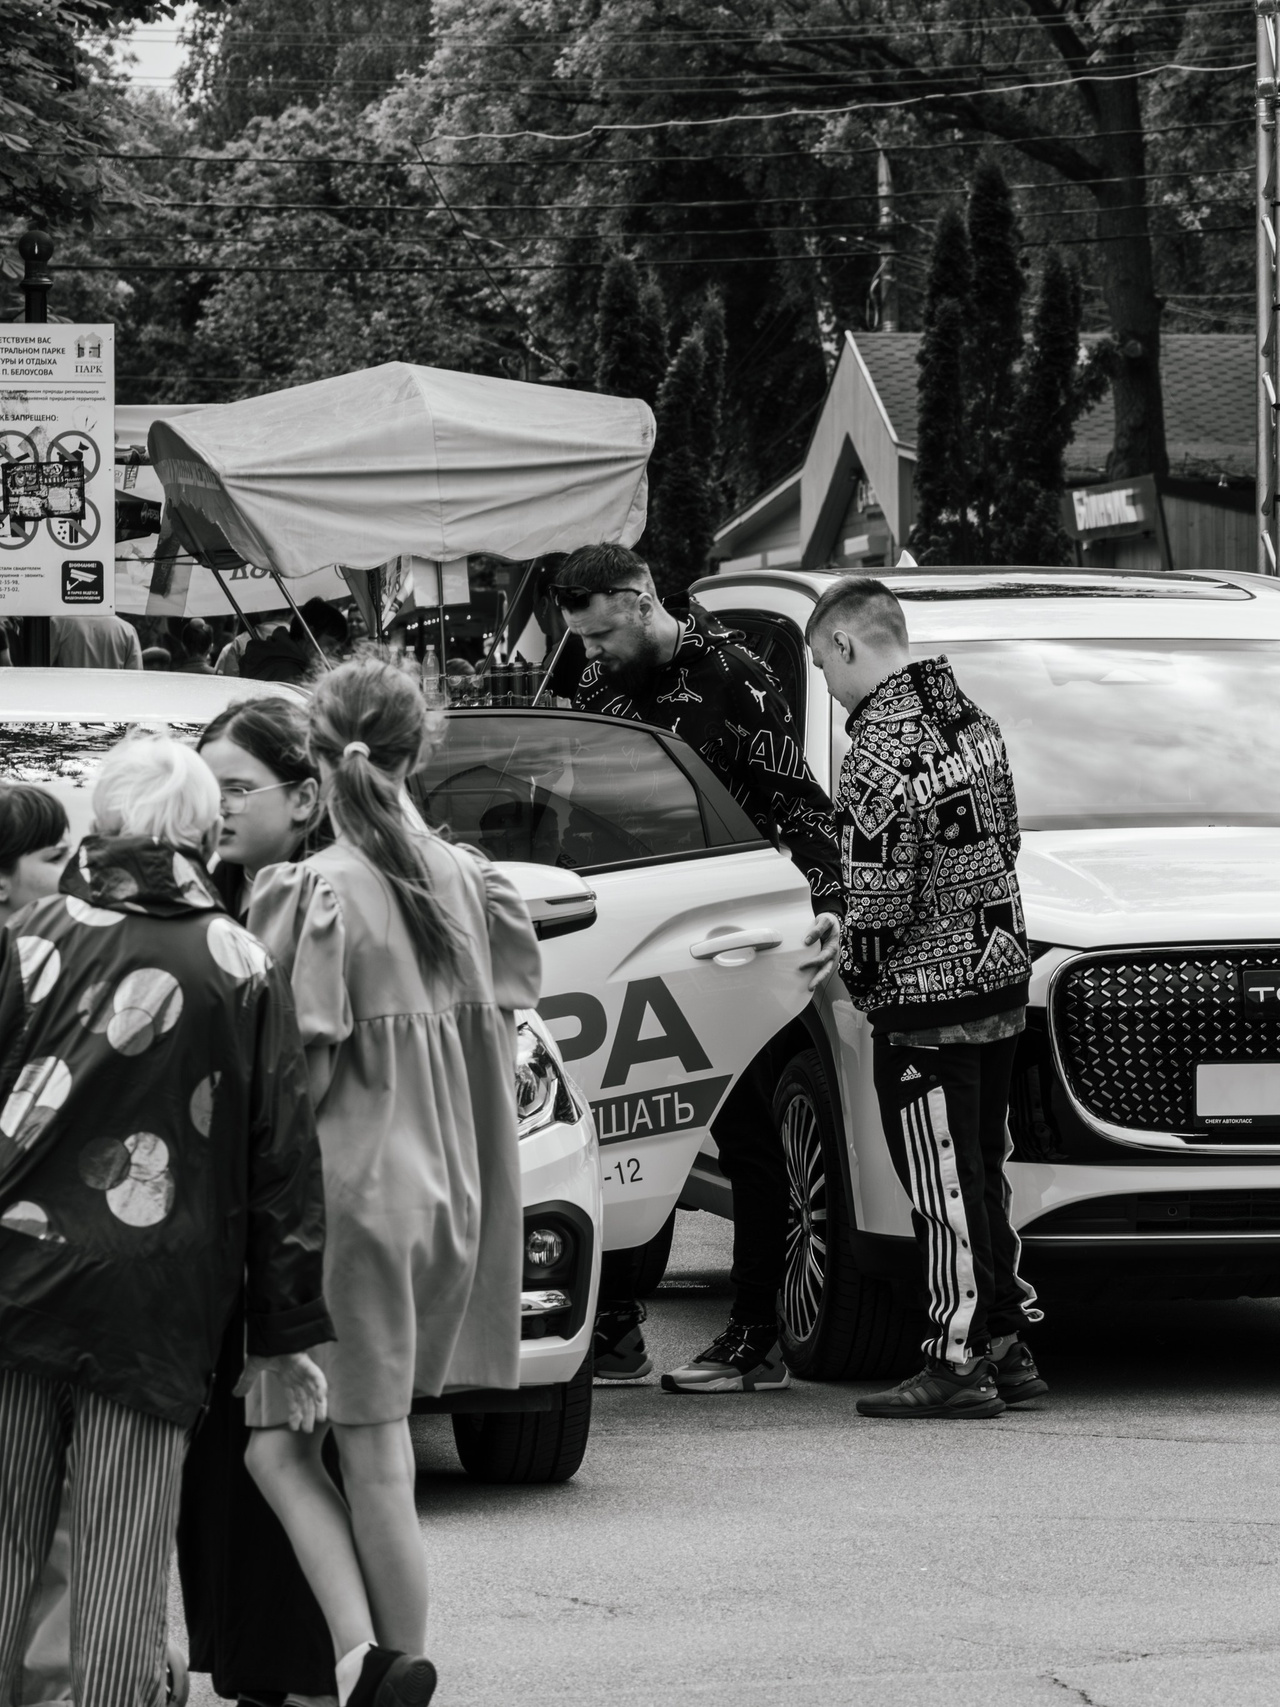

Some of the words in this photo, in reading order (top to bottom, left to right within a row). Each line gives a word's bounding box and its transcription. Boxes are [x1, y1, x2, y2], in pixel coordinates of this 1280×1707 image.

[37, 336, 52, 344] ВАС
[41, 347, 66, 355] ПАРКЕ
[25, 358, 57, 366] ОТДЫХА
[11, 368, 54, 376] БЕЛОУСОВА
[75, 365, 103, 374] ПАРК
[11, 414, 59, 422] ЗАПРЕЩЕНО:
[900, 1072, 922, 1082] adidas
[591, 1091, 695, 1140] ШАТЬ
[603, 1157, 644, 1185] -12
